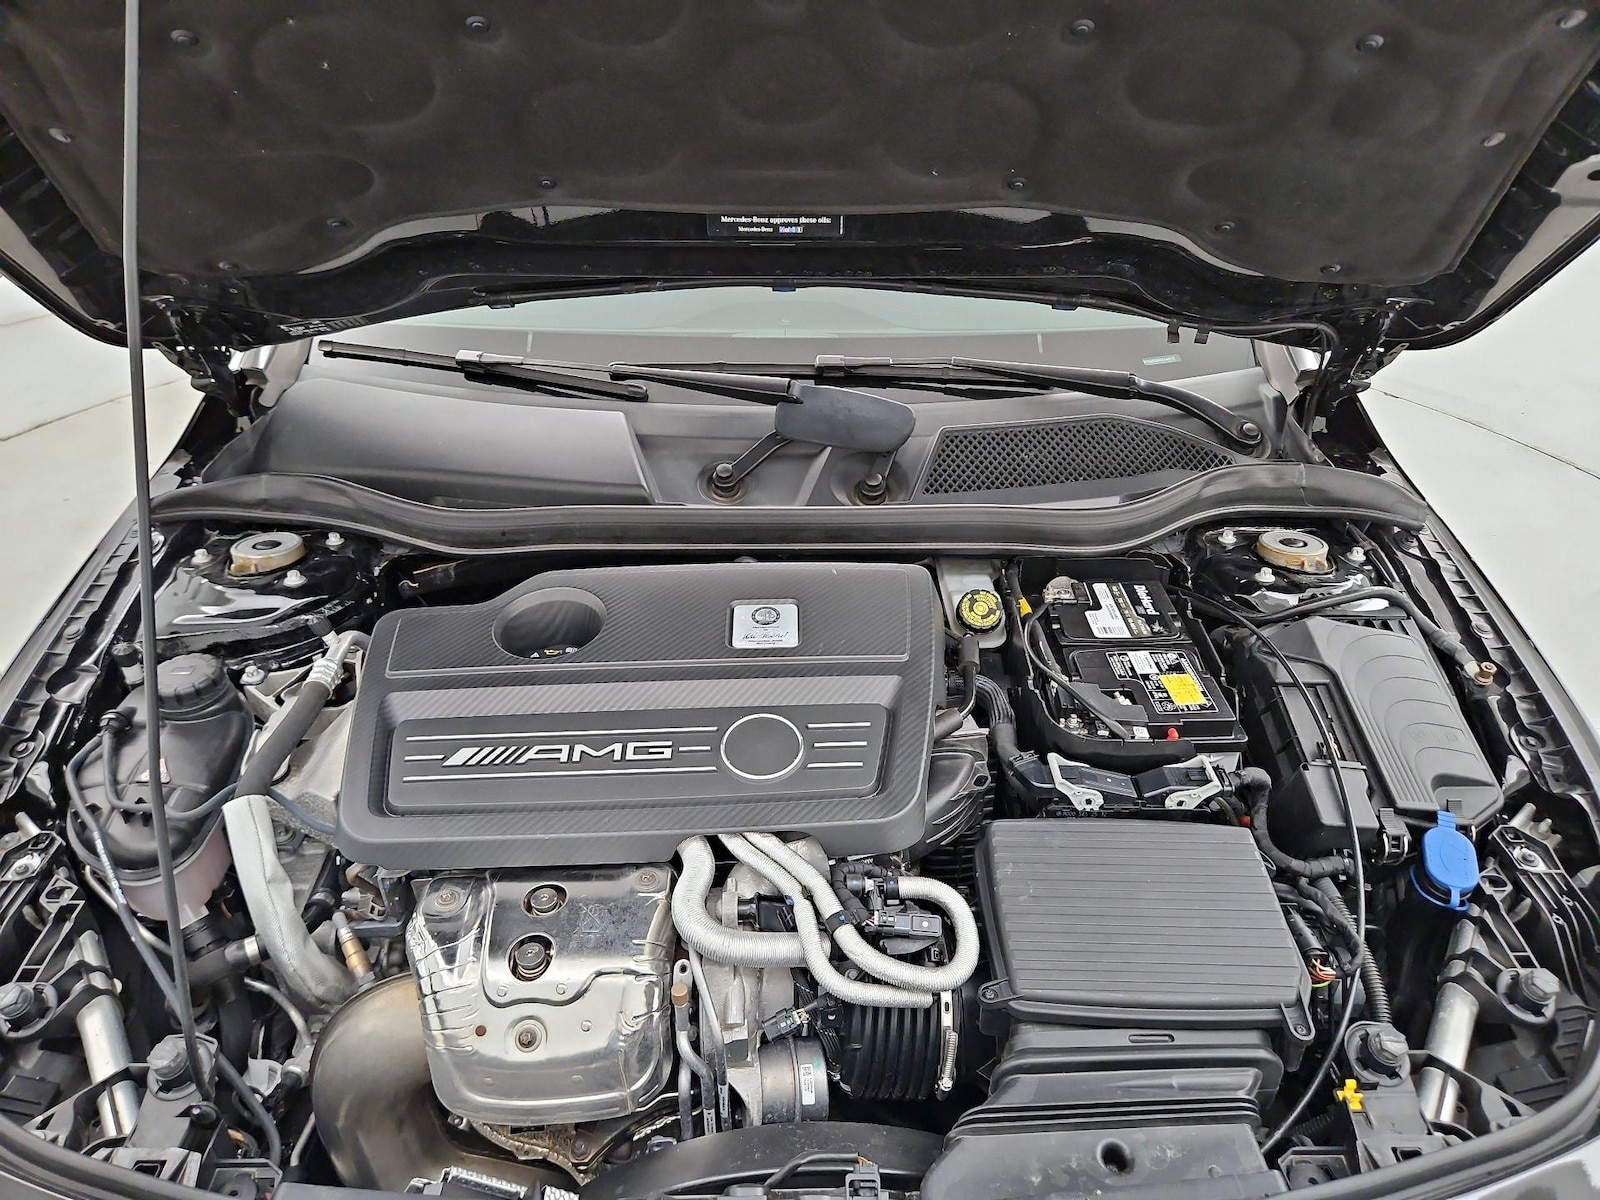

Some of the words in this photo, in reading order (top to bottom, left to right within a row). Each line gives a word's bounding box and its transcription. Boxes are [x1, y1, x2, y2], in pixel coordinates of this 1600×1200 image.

[720, 215, 769, 224] Mercedes-Benz
[770, 216, 798, 225] approves
[799, 216, 817, 224] these
[1133, 584, 1160, 615] DieHard
[515, 740, 673, 764] AMG
